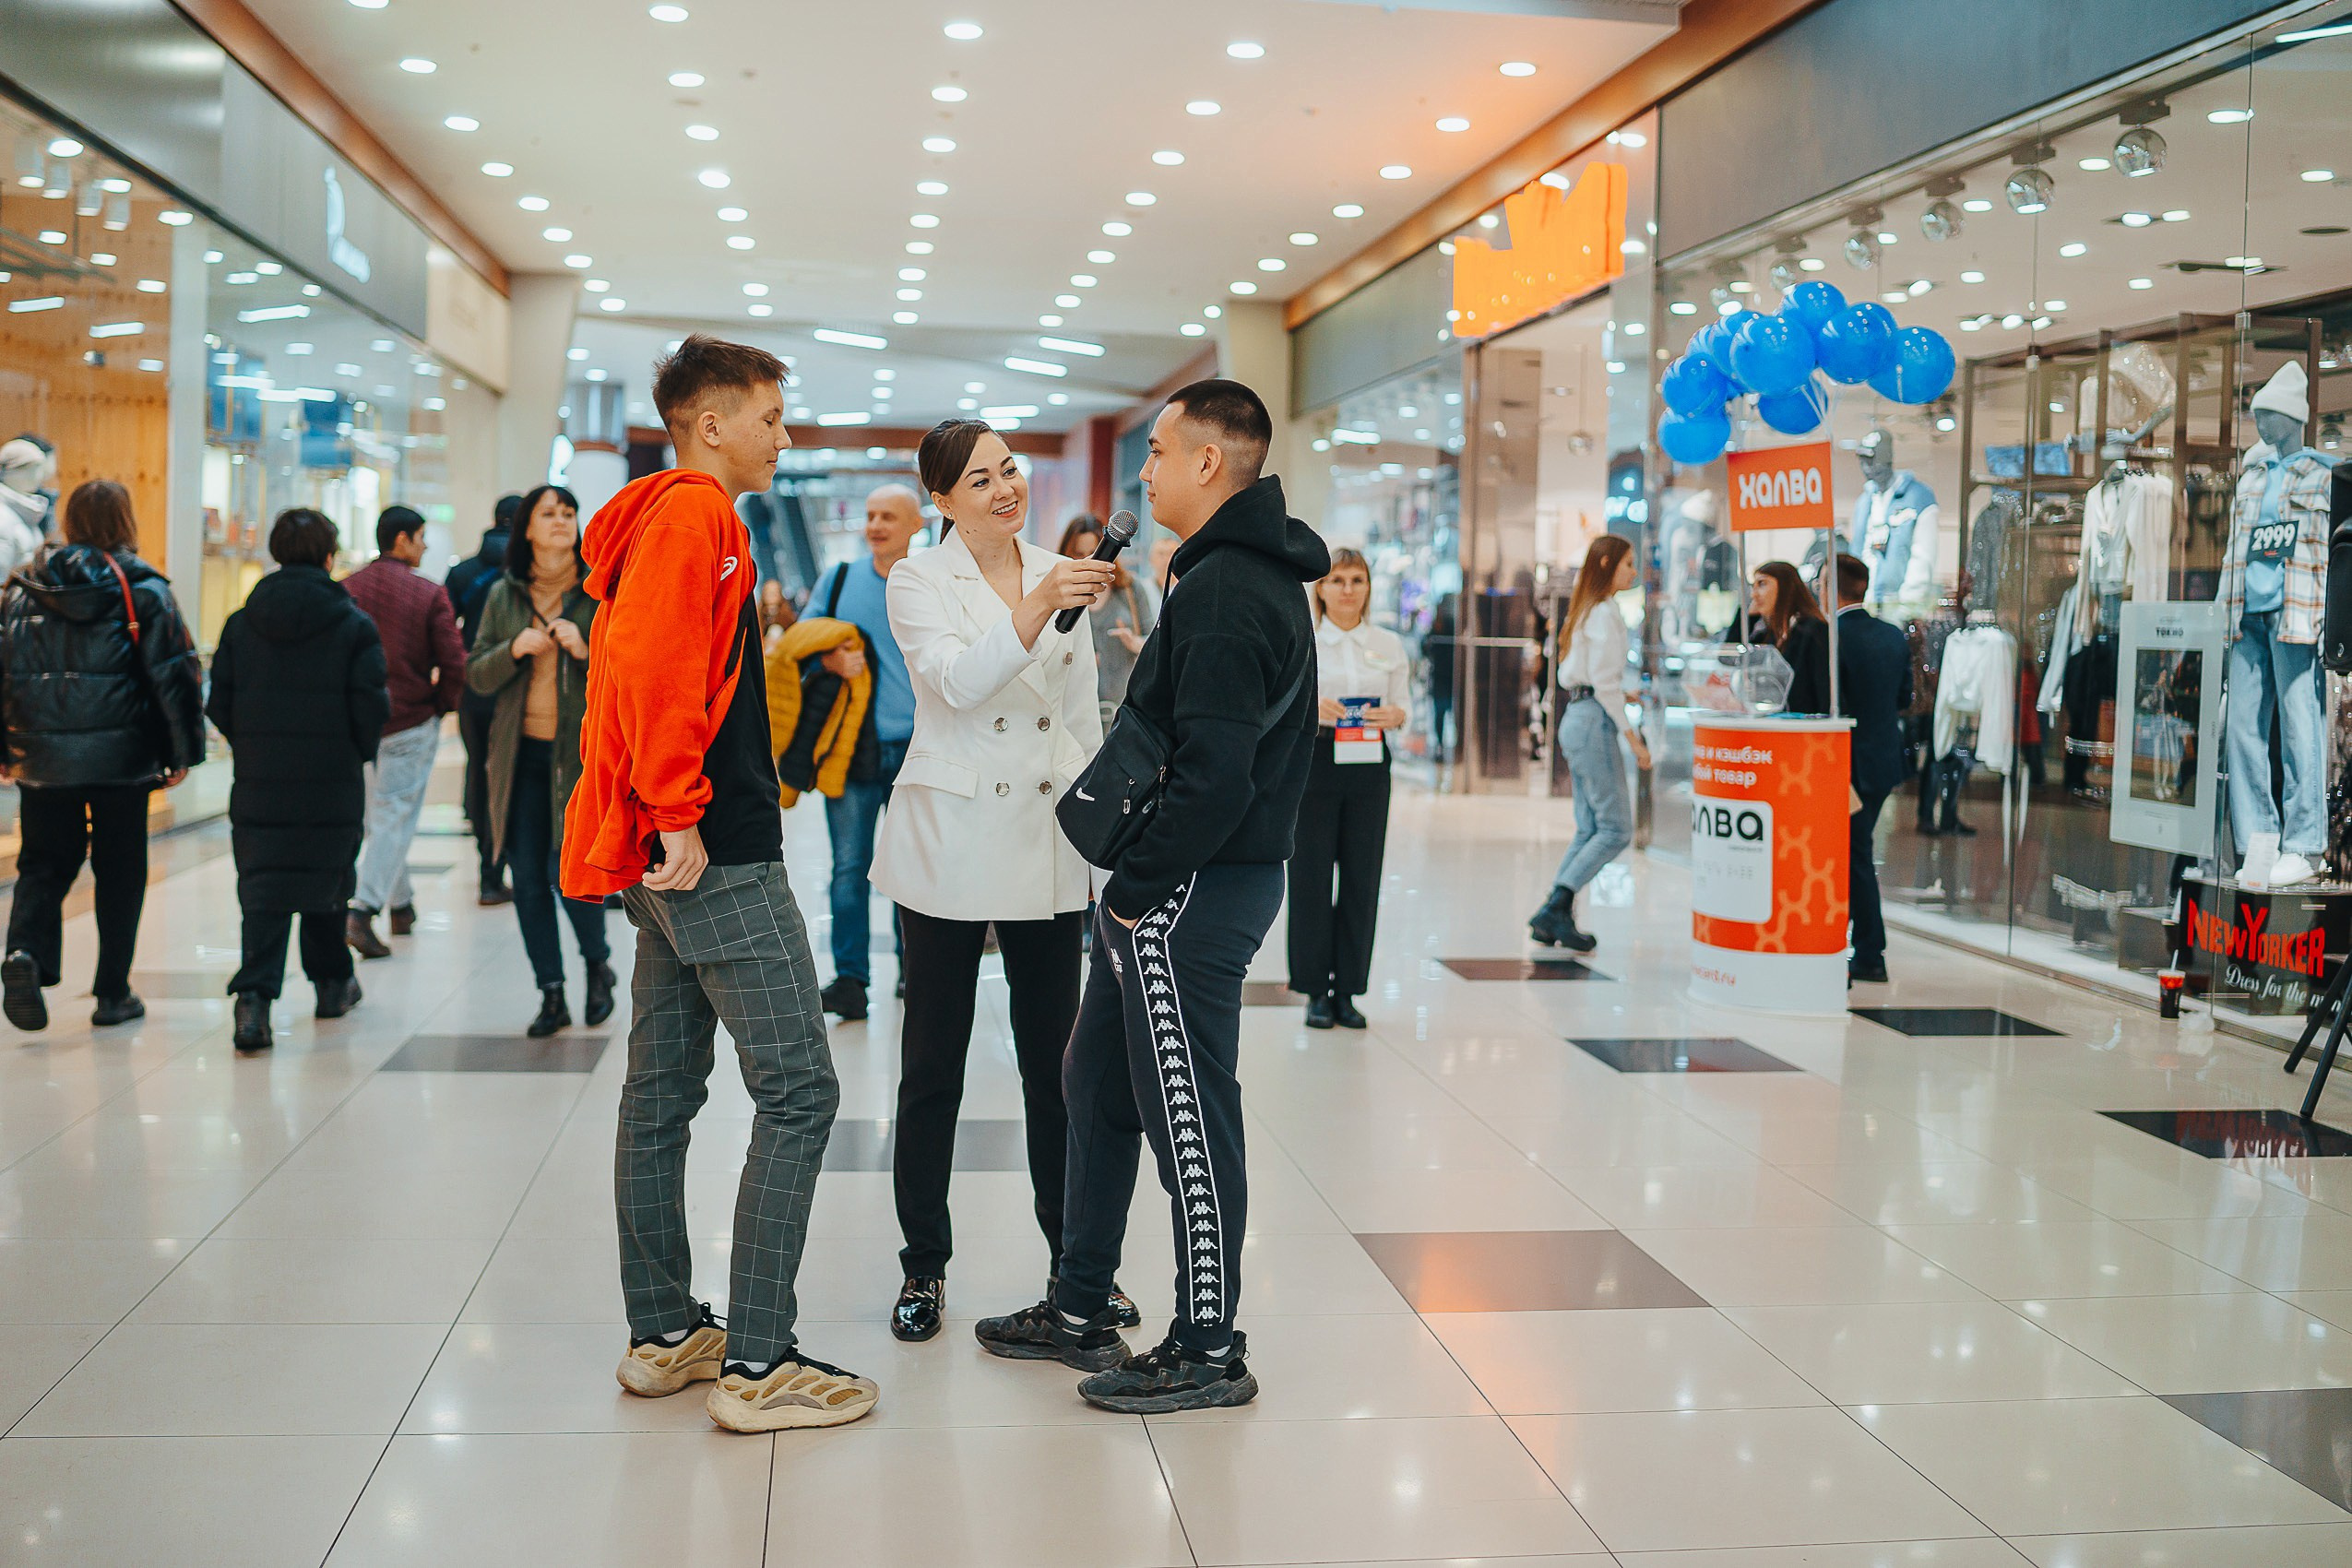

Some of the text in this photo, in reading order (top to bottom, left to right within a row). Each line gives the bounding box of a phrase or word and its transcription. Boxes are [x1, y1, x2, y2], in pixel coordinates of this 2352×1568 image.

[2251, 523, 2296, 552] 2999
[1715, 745, 1773, 765] кэшбэк
[1714, 768, 1757, 789] товар
[1692, 802, 1764, 841] лва
[2225, 963, 2260, 993] Dress
[2258, 974, 2282, 1001] for
[2286, 980, 2308, 1005] the
